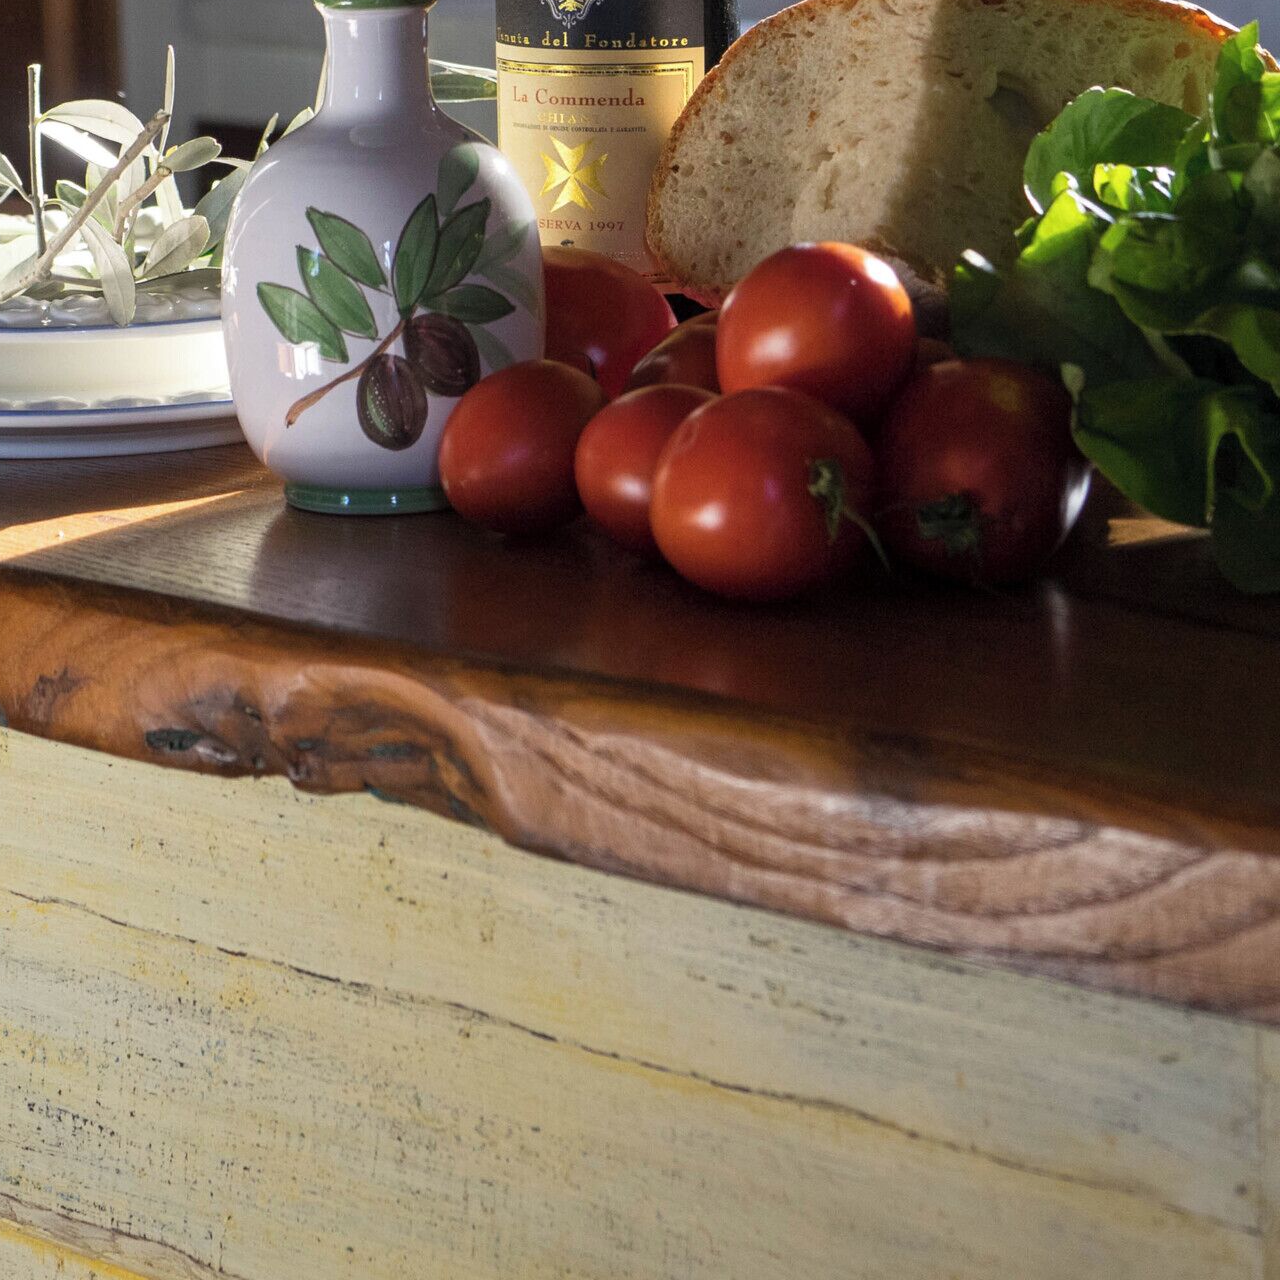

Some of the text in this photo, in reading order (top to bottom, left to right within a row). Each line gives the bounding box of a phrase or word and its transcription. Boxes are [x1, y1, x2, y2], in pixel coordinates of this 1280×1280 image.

[541, 31, 569, 47] del
[584, 32, 689, 48] Fondatore
[513, 85, 646, 107] La Commenda
[538, 218, 625, 232] SERVA 1997
